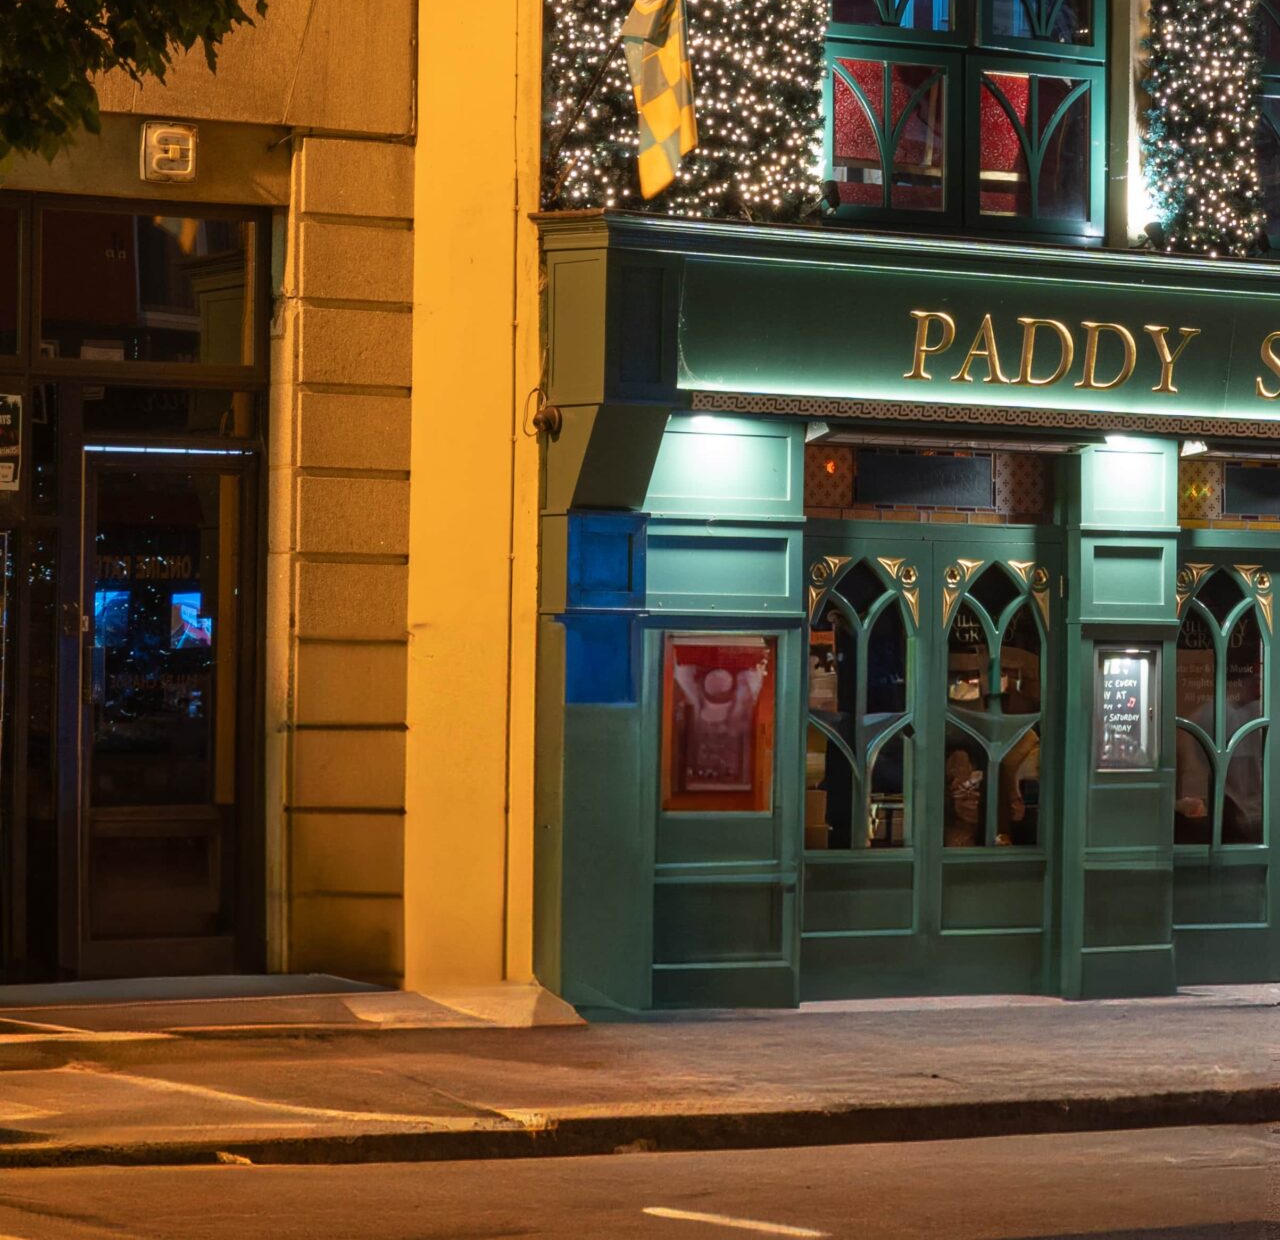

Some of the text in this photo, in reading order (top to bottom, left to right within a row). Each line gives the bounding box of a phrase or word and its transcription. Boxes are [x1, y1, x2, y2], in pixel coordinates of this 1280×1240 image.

[903, 310, 1201, 394] PADDY
[1115, 680, 1138, 688] EVERY
[1116, 691, 1127, 700] AT
[1109, 713, 1140, 722] SATURDAY
